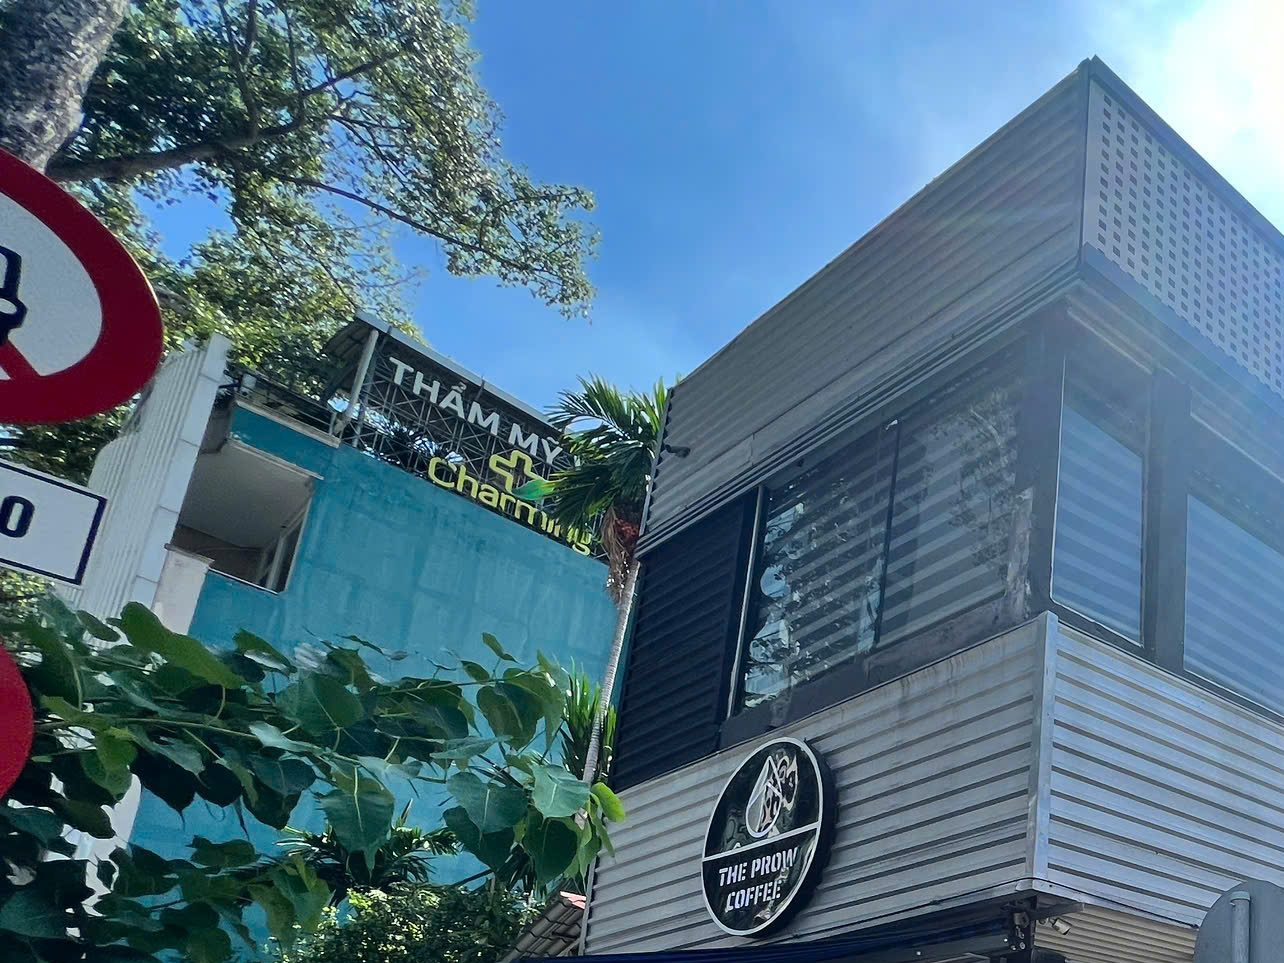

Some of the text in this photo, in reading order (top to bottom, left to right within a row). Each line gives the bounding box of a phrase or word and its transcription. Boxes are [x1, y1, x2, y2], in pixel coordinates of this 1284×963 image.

[718, 847, 800, 887] THE PROW
[725, 879, 783, 913] COFFEE
